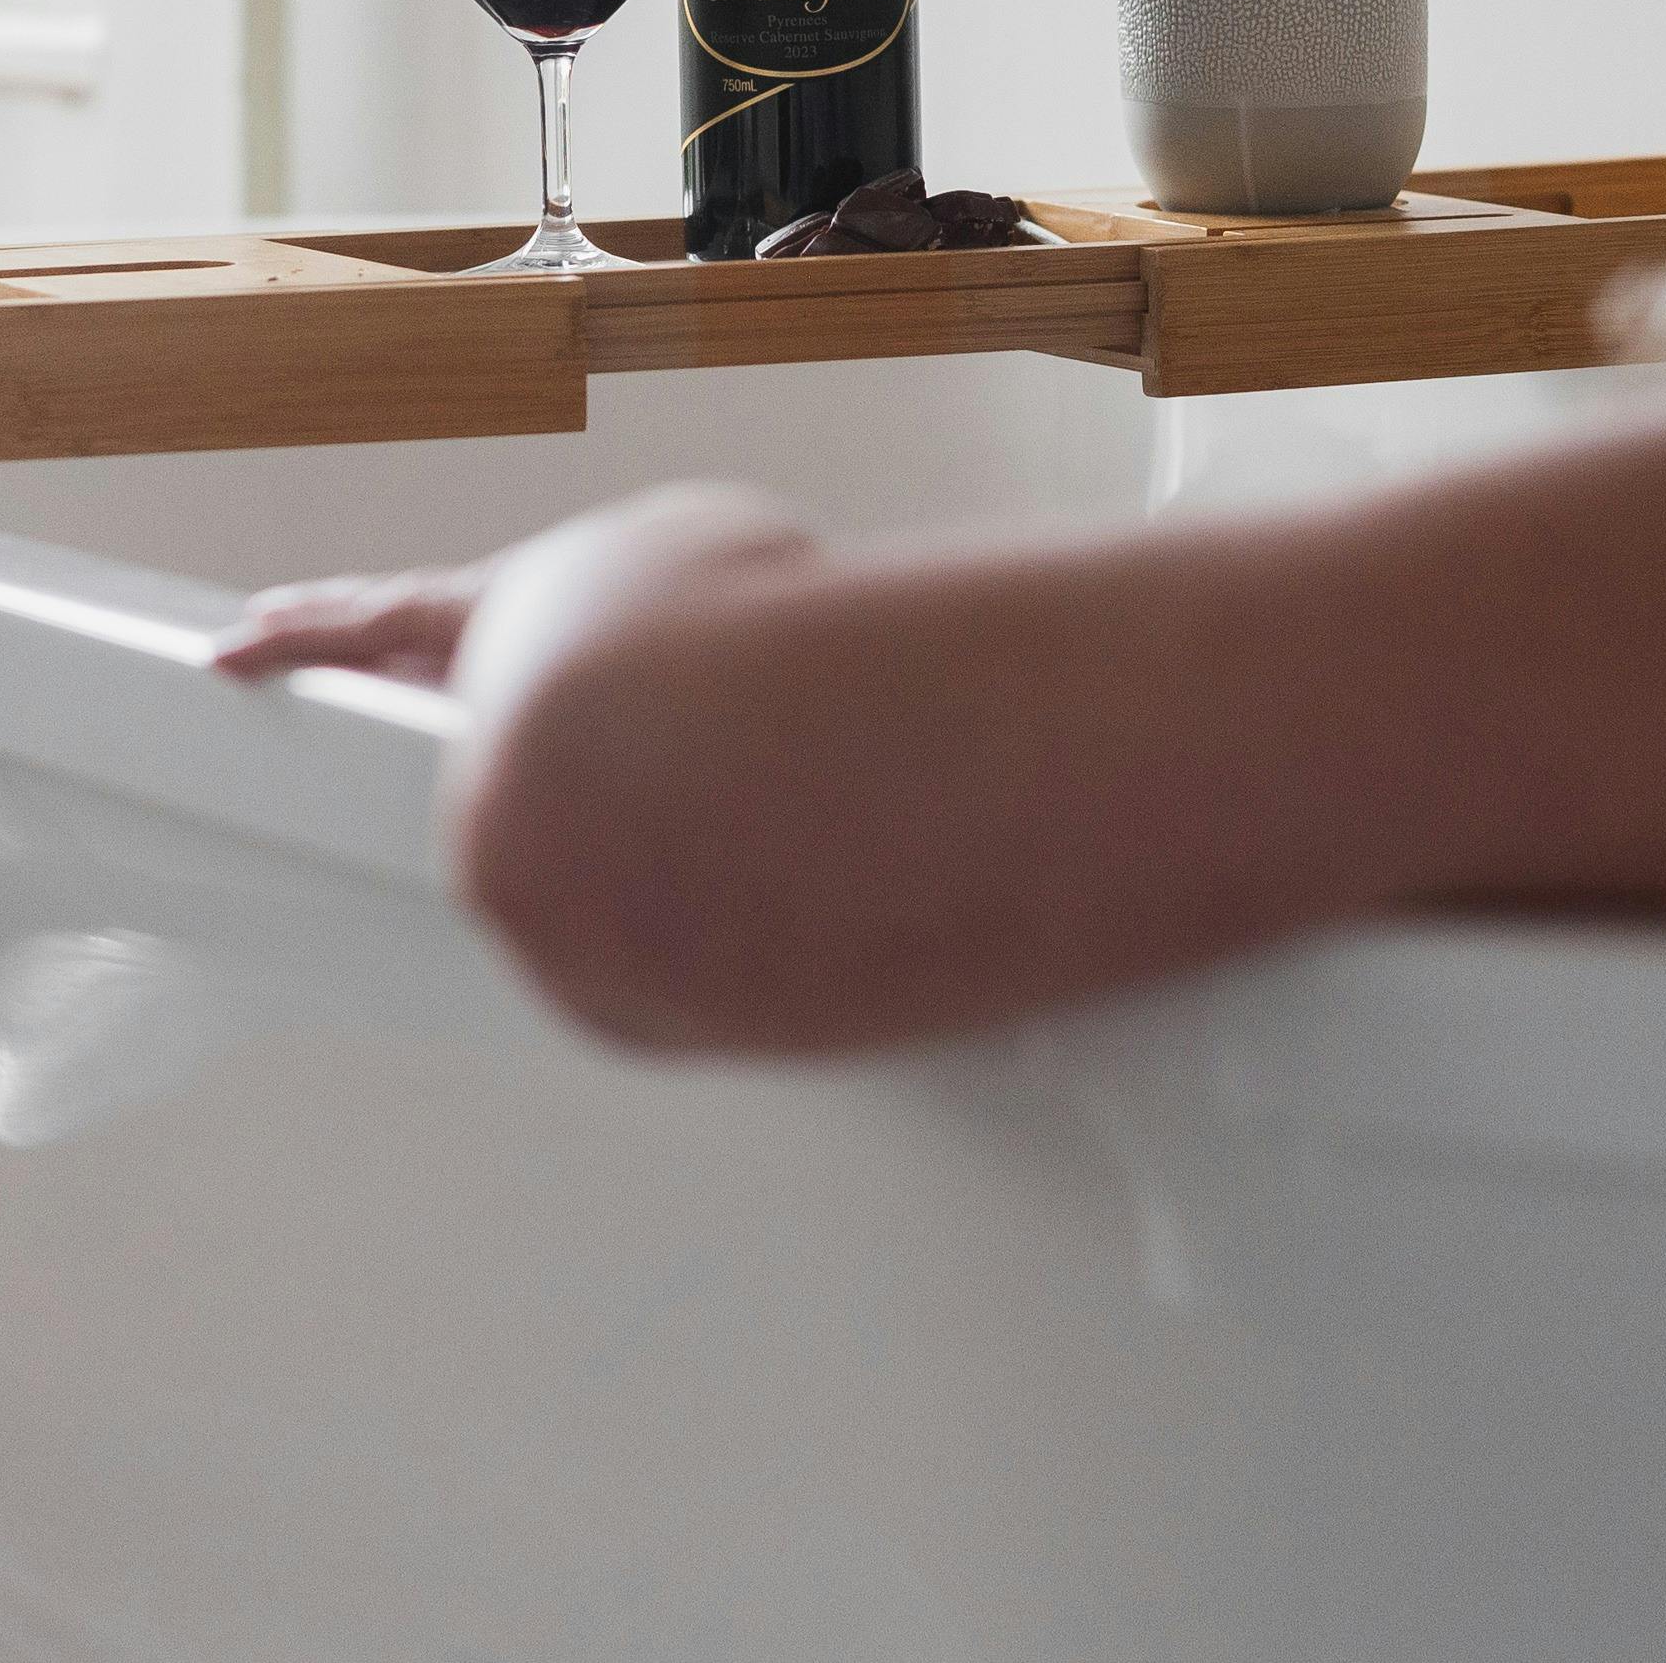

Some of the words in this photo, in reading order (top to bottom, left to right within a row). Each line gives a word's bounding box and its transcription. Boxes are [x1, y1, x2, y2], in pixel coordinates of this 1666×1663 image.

[767, 15, 828, 29] Pyrenees
[759, 30, 821, 44] Cabernet
[784, 45, 818, 58] 2023
[722, 79, 758, 92] 750mL
